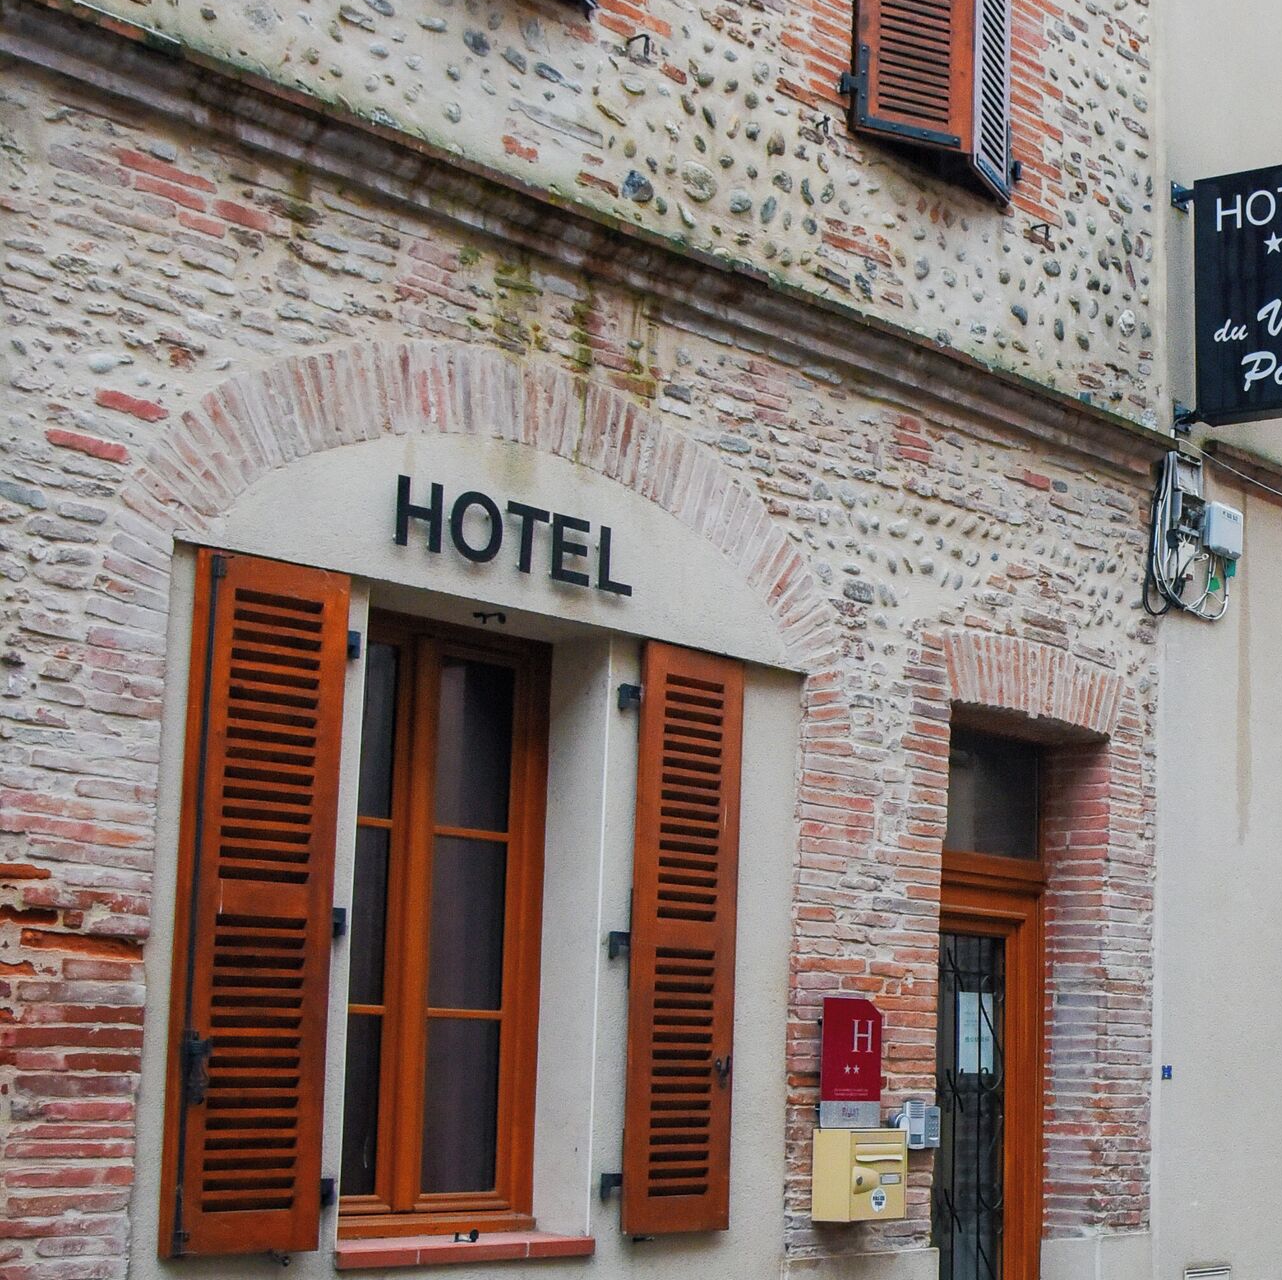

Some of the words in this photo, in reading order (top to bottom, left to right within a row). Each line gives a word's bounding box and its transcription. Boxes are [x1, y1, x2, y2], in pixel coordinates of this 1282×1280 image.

[1213, 318, 1249, 342] du
[394, 473, 633, 598] HOTEL
[851, 1018, 875, 1053] H
